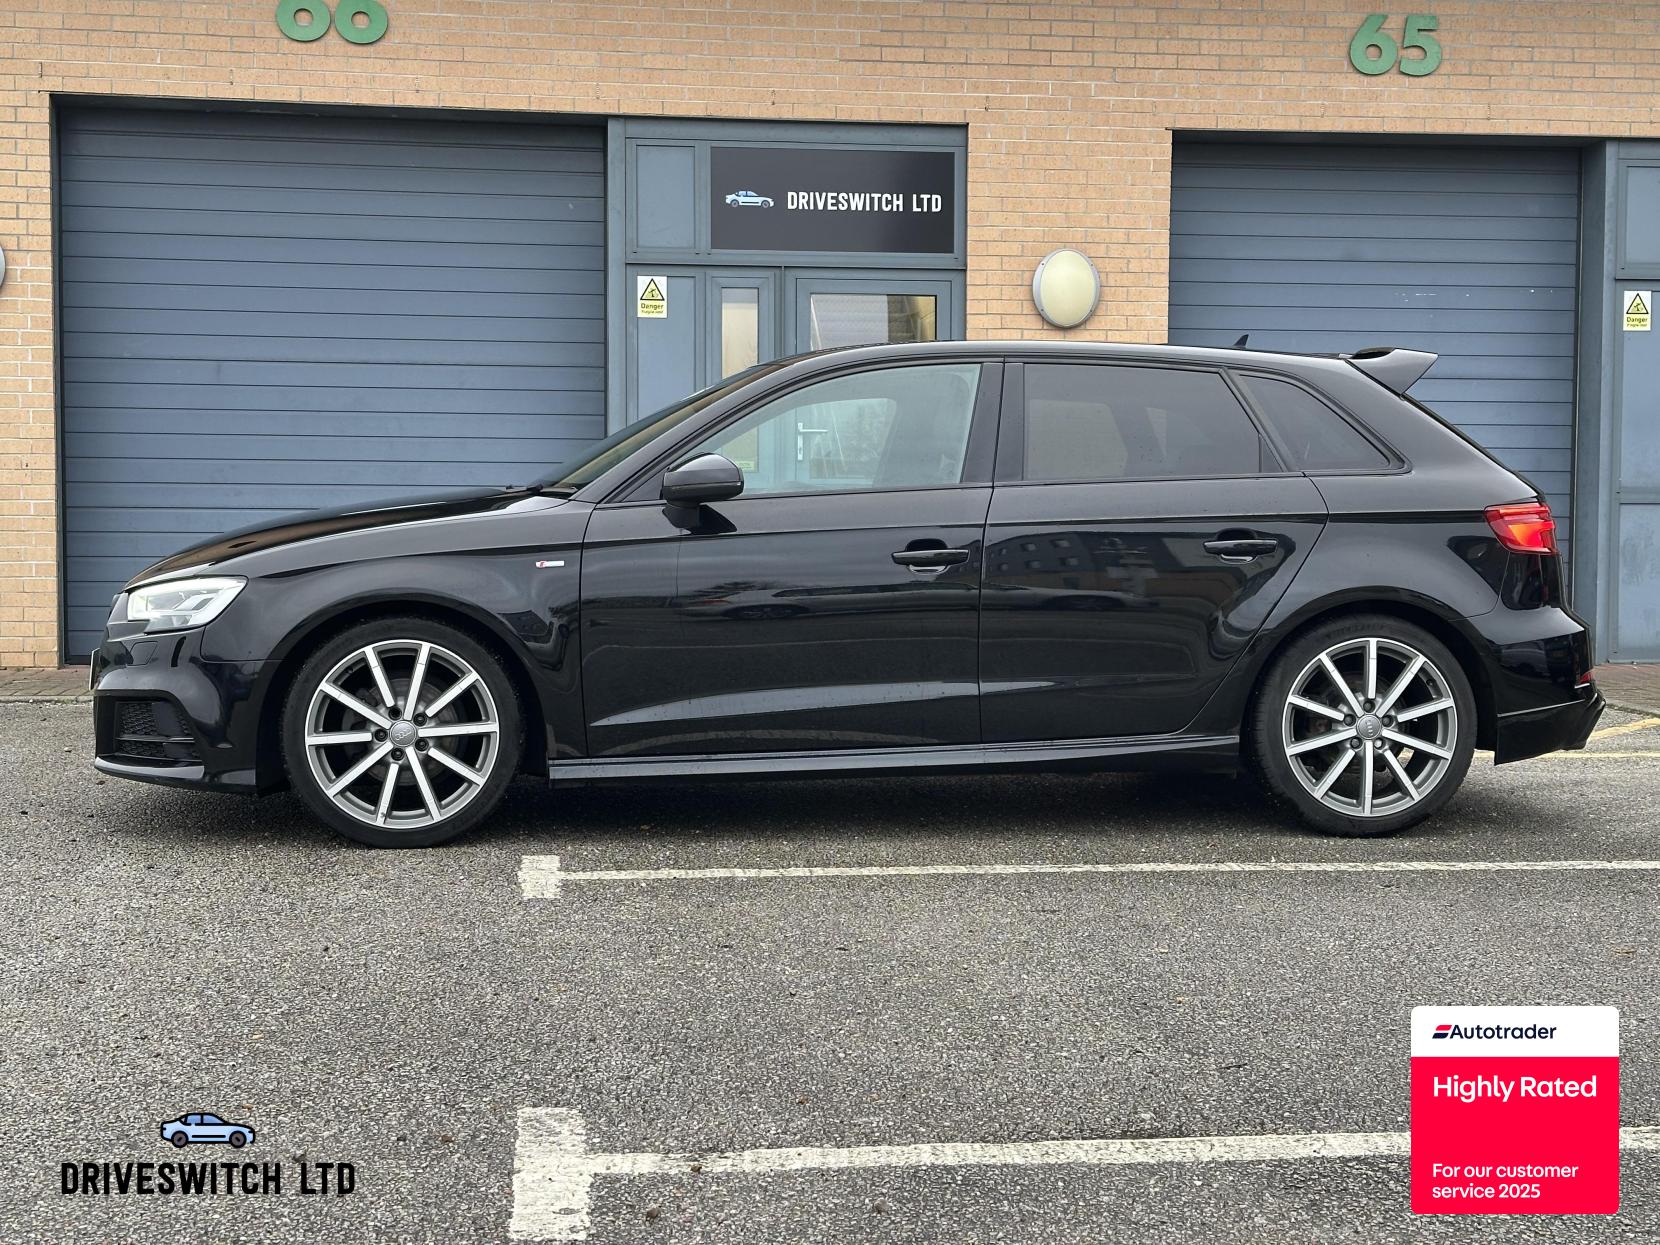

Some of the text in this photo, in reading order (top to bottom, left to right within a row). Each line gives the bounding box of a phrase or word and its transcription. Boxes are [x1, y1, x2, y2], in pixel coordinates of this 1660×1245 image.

[1349, 14, 1442, 77] 65
[787, 191, 942, 213] DRIVESWITCH LTD
[640, 303, 664, 311] Danger
[1626, 316, 1648, 324] Danger
